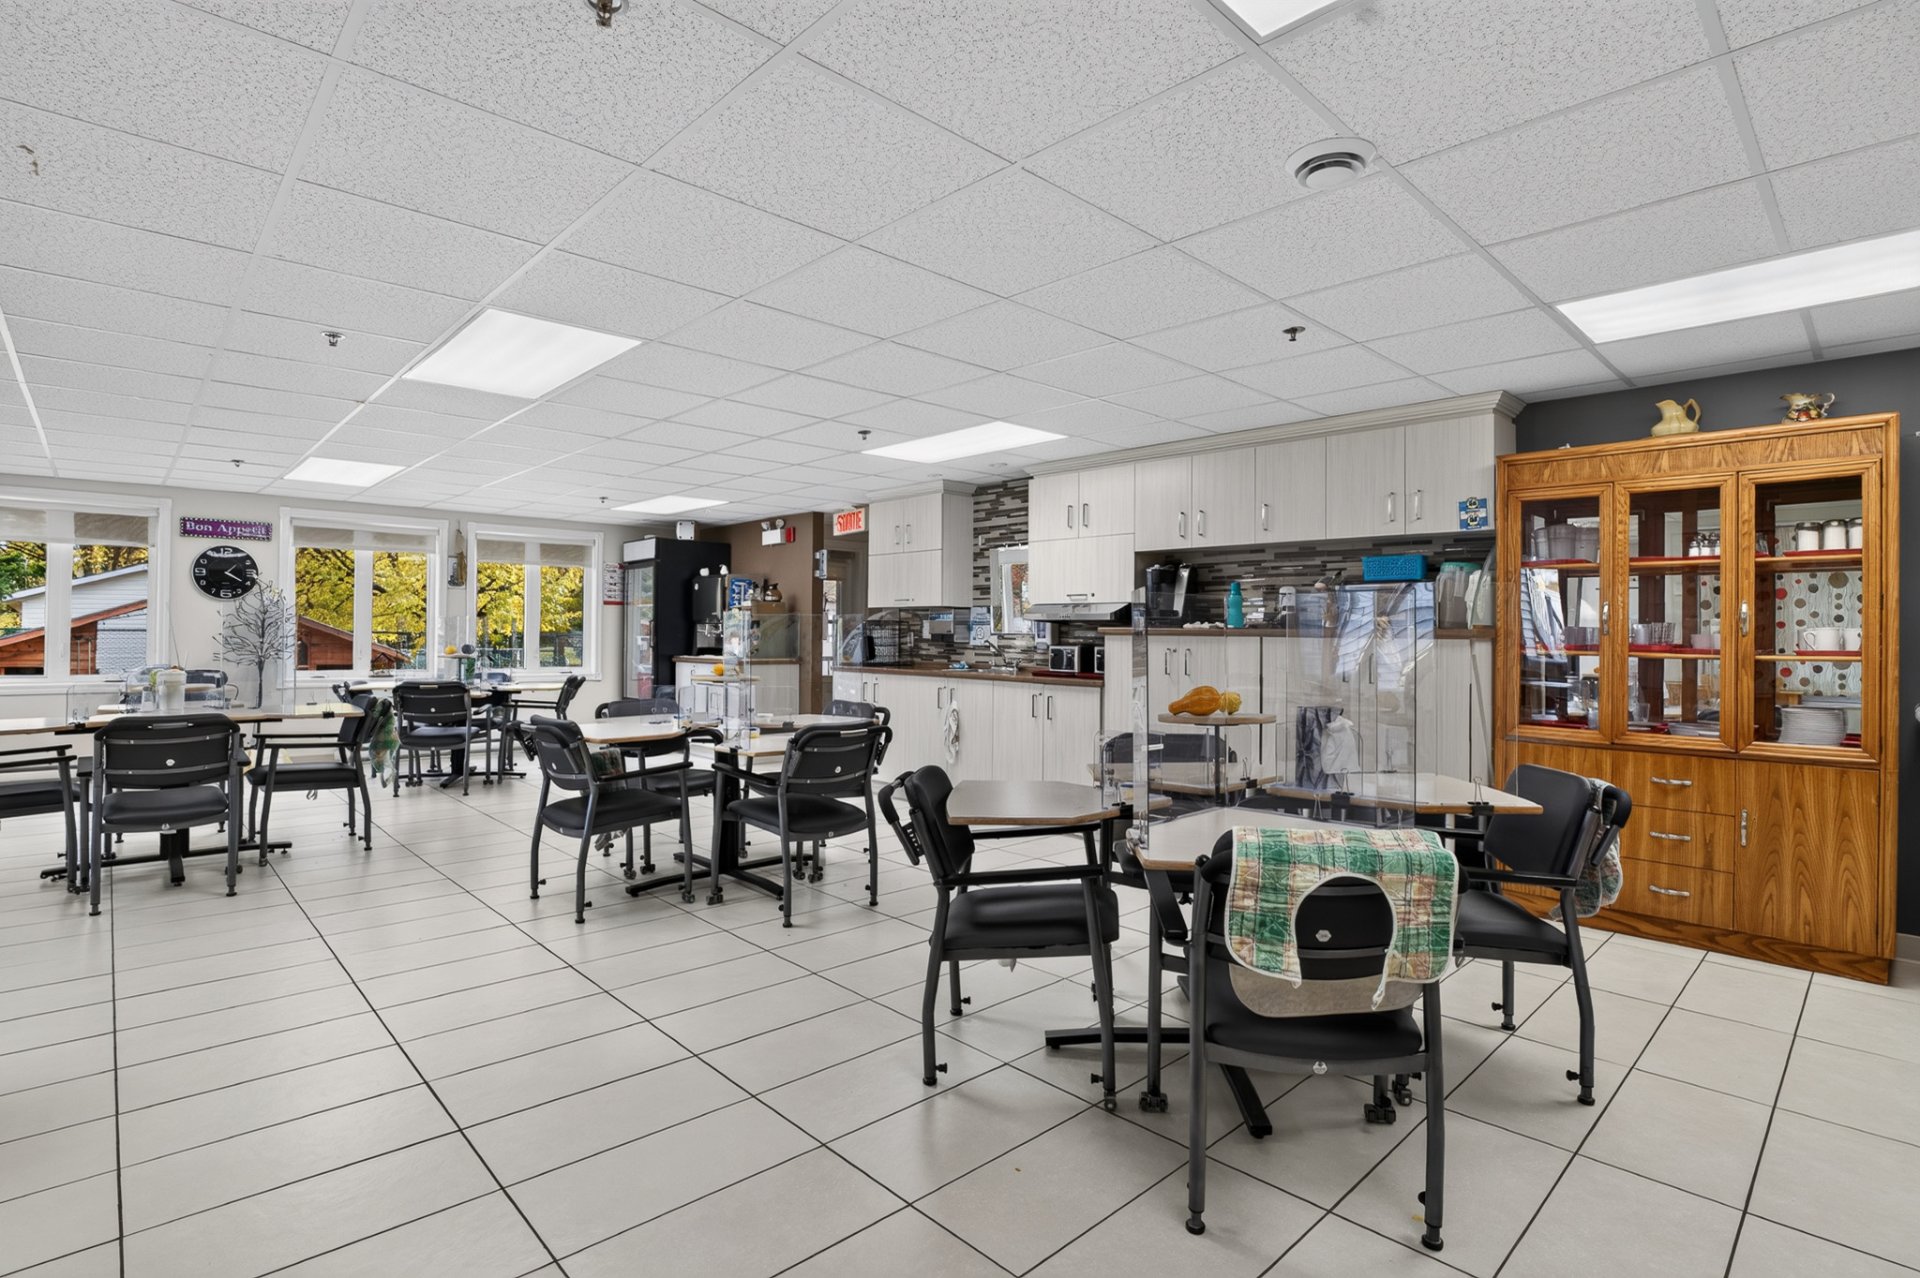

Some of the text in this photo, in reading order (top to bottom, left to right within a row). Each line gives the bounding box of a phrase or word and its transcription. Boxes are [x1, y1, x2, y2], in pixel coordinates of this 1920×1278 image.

[837, 510, 862, 532] SORTIE
[186, 521, 212, 532] Bon
[195, 567, 206, 576] 9
[220, 589, 232, 598] 6
